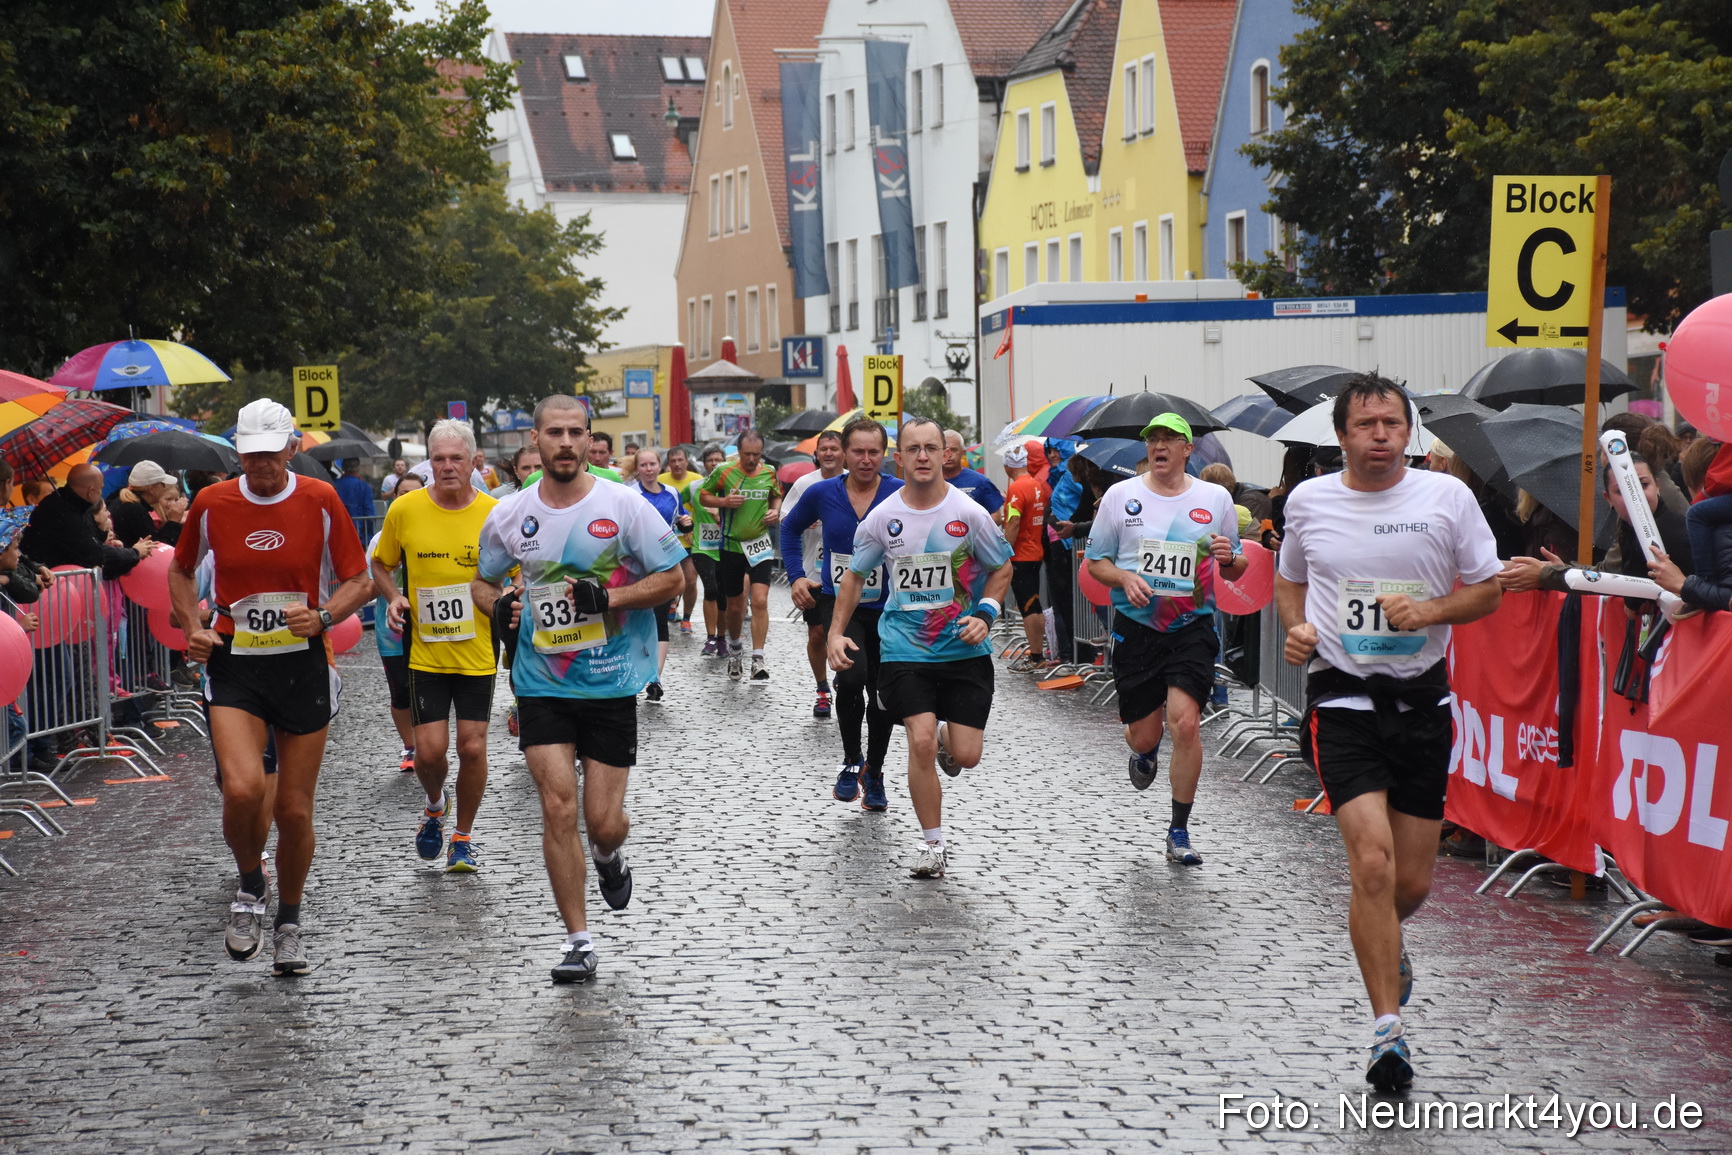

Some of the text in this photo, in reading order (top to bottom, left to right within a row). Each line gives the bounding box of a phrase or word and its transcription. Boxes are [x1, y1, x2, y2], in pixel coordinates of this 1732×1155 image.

[789, 141, 817, 211] K&L
[1506, 183, 1595, 213] Block
[1031, 201, 1057, 231] HOTEL
[1517, 227, 1577, 312] C
[868, 358, 898, 369] Block
[299, 369, 333, 381] Block
[874, 375, 893, 406] D
[306, 386, 328, 418] D
[521, 540, 540, 549] PARTL
[746, 539, 772, 556] 2894
[1164, 542, 1193, 552] BOCK
[1143, 552, 1191, 577] 2410
[834, 565, 878, 587] 23
[899, 566, 947, 589] 2477
[1153, 579, 1176, 589] Erwin
[1381, 582, 1425, 593] BOCK
[263, 593, 301, 603] BOCK
[910, 593, 940, 602] Damian
[426, 599, 463, 621] 130
[1347, 599, 1418, 632] 31
[432, 625, 461, 634] Norbert
[552, 630, 582, 644] Jamal
[250, 635, 281, 647] Martin
